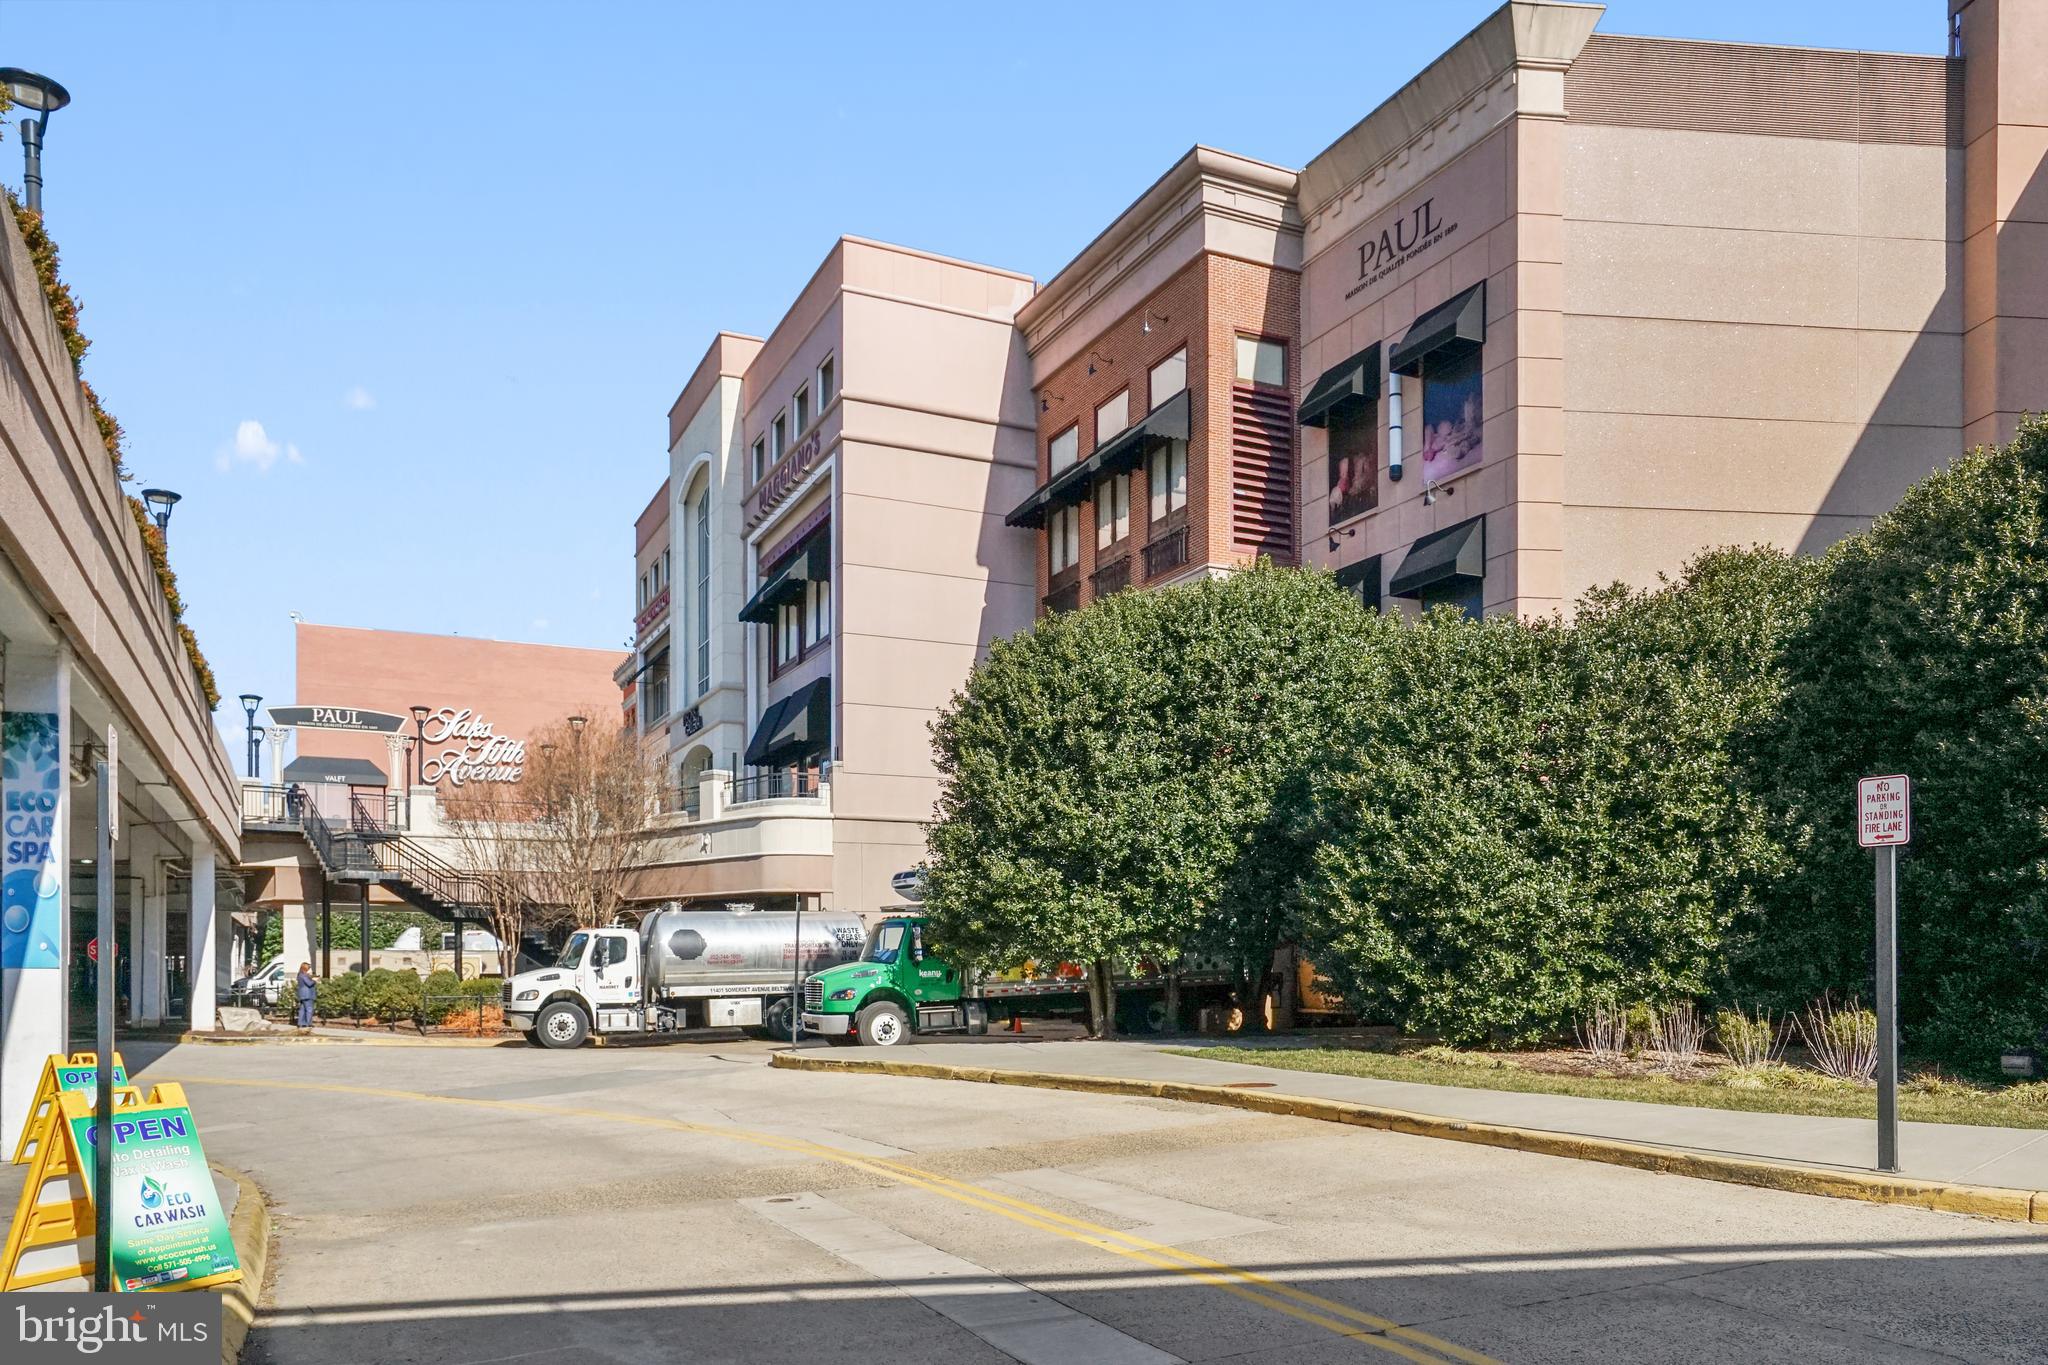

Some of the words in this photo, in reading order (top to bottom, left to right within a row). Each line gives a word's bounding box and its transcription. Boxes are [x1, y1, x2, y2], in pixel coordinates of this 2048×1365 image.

[1358, 197, 1442, 280] PAUL
[1345, 281, 1368, 301] MAISON
[1369, 275, 1377, 285] DE
[1433, 232, 1443, 245] EN
[759, 430, 820, 511] MAGGIANO'S
[311, 708, 363, 724] PAUL
[422, 707, 494, 743] Saks
[463, 735, 525, 766] Fifth
[422, 749, 522, 785] Avenue
[325, 775, 346, 783] VALET
[1876, 782, 1890, 792] NO
[5, 791, 56, 813] ECO
[1866, 792, 1901, 803] PARKING
[1864, 810, 1903, 821] STANDING
[5, 815, 54, 838] CAR
[1865, 823, 1880, 833] FIRE
[1882, 821, 1903, 832] LANE
[7, 841, 55, 865] SPA
[841, 940, 859, 948] ONLY
[113, 1152, 129, 1162] to
[133, 1145, 191, 1160] Detailing
[152, 1158, 188, 1171] Wash
[167, 1192, 191, 1206] ECO
[135, 1212, 164, 1228] CAR
[164, 1204, 206, 1222] WASH
[135, 1243, 217, 1266] www.ecocarwash.us
[138, 1248, 146, 1256] or
[149, 1238, 200, 1254] Appointment
[147, 1262, 163, 1273] Call
